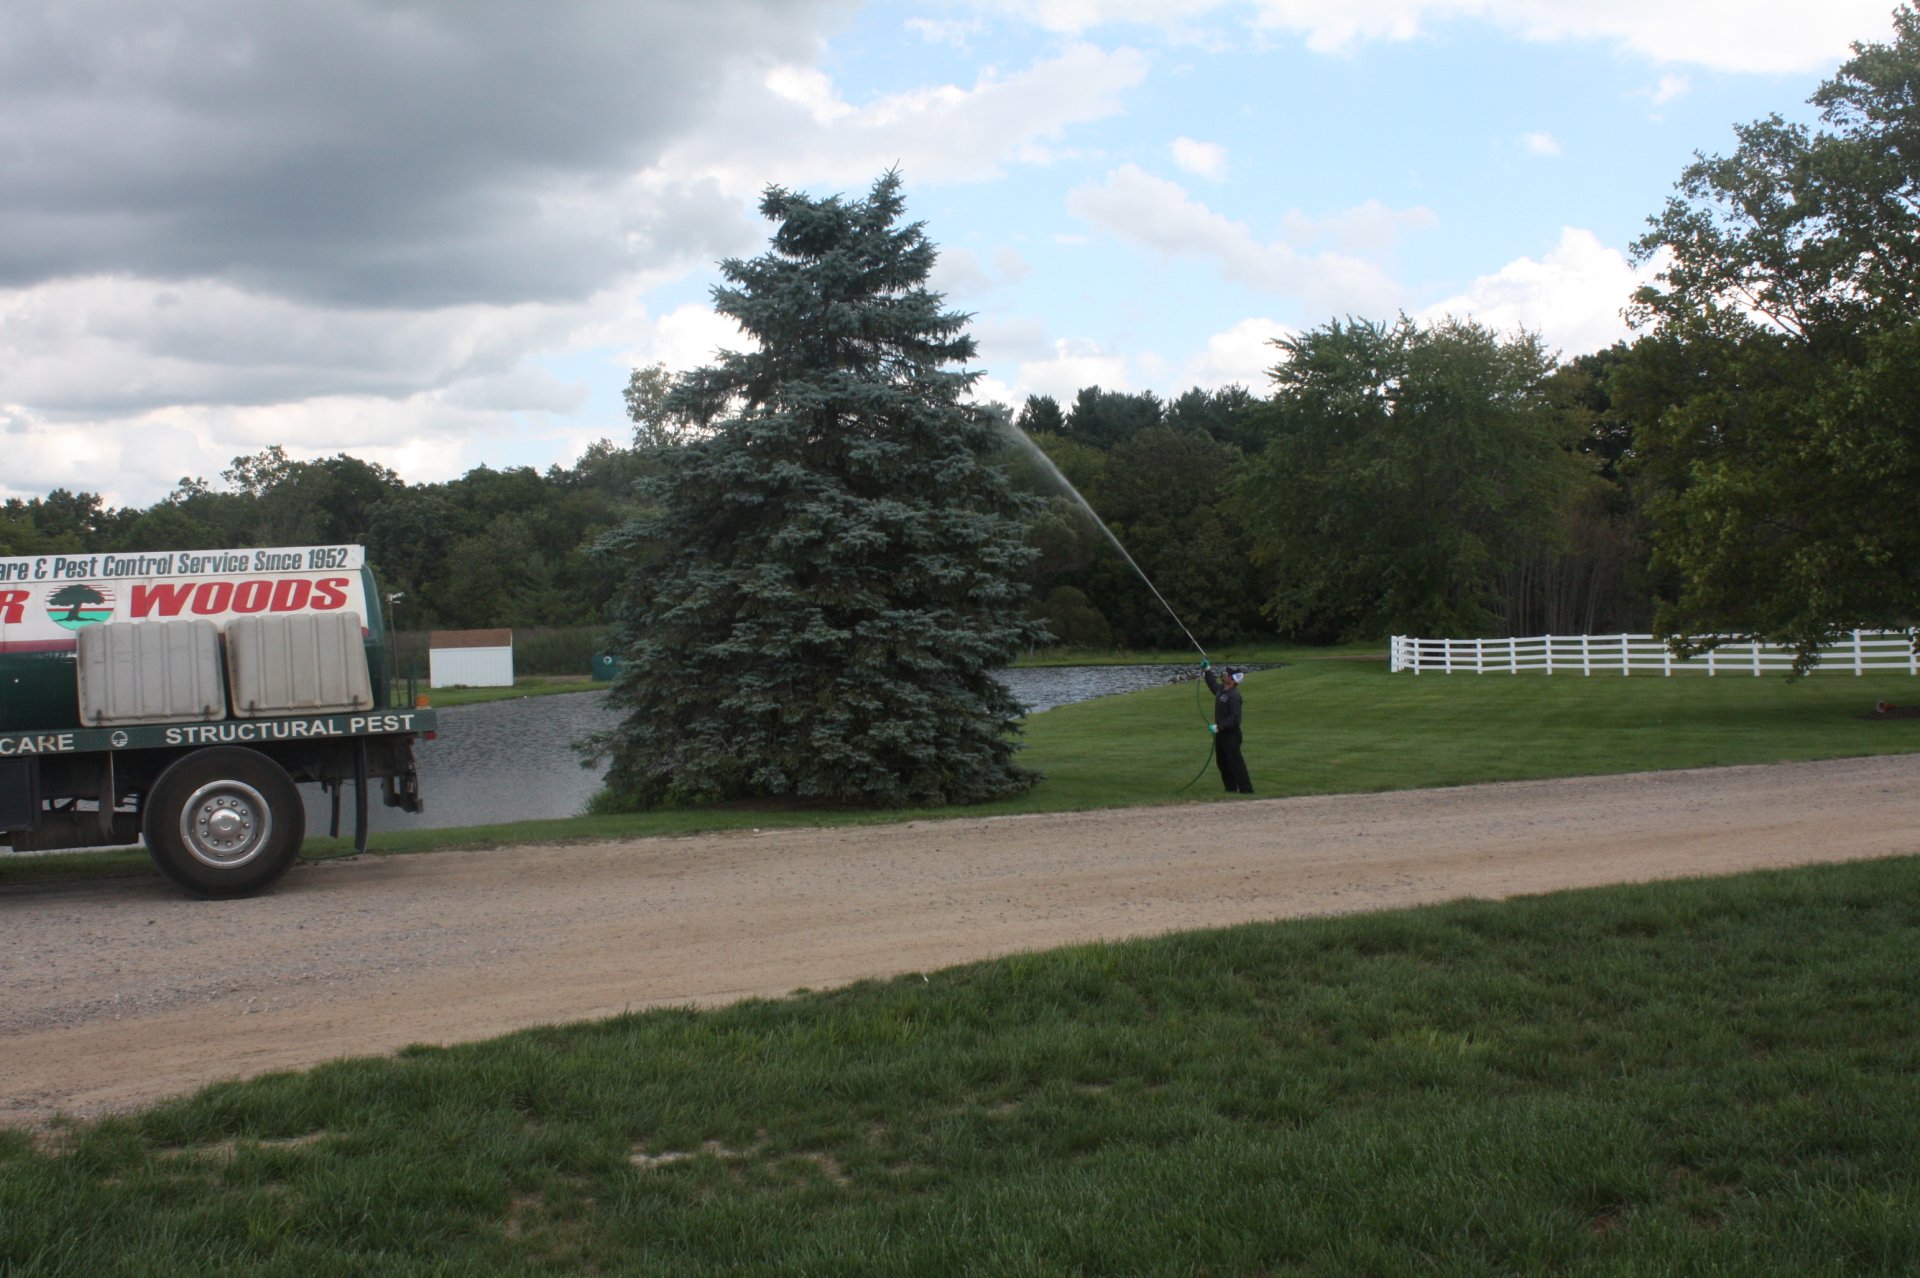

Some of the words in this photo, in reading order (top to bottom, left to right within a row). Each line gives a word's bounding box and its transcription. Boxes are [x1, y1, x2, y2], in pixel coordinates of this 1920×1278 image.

[34, 557, 48, 580] &
[53, 556, 98, 579] Pest
[103, 554, 174, 577] Control
[178, 552, 249, 574] Service
[254, 550, 302, 571] Since
[308, 547, 348, 570] 1952
[130, 577, 350, 618] WOODS
[0, 733, 75, 755] CARE
[165, 719, 343, 744] STRUCTURAL
[350, 714, 415, 734] PEST
